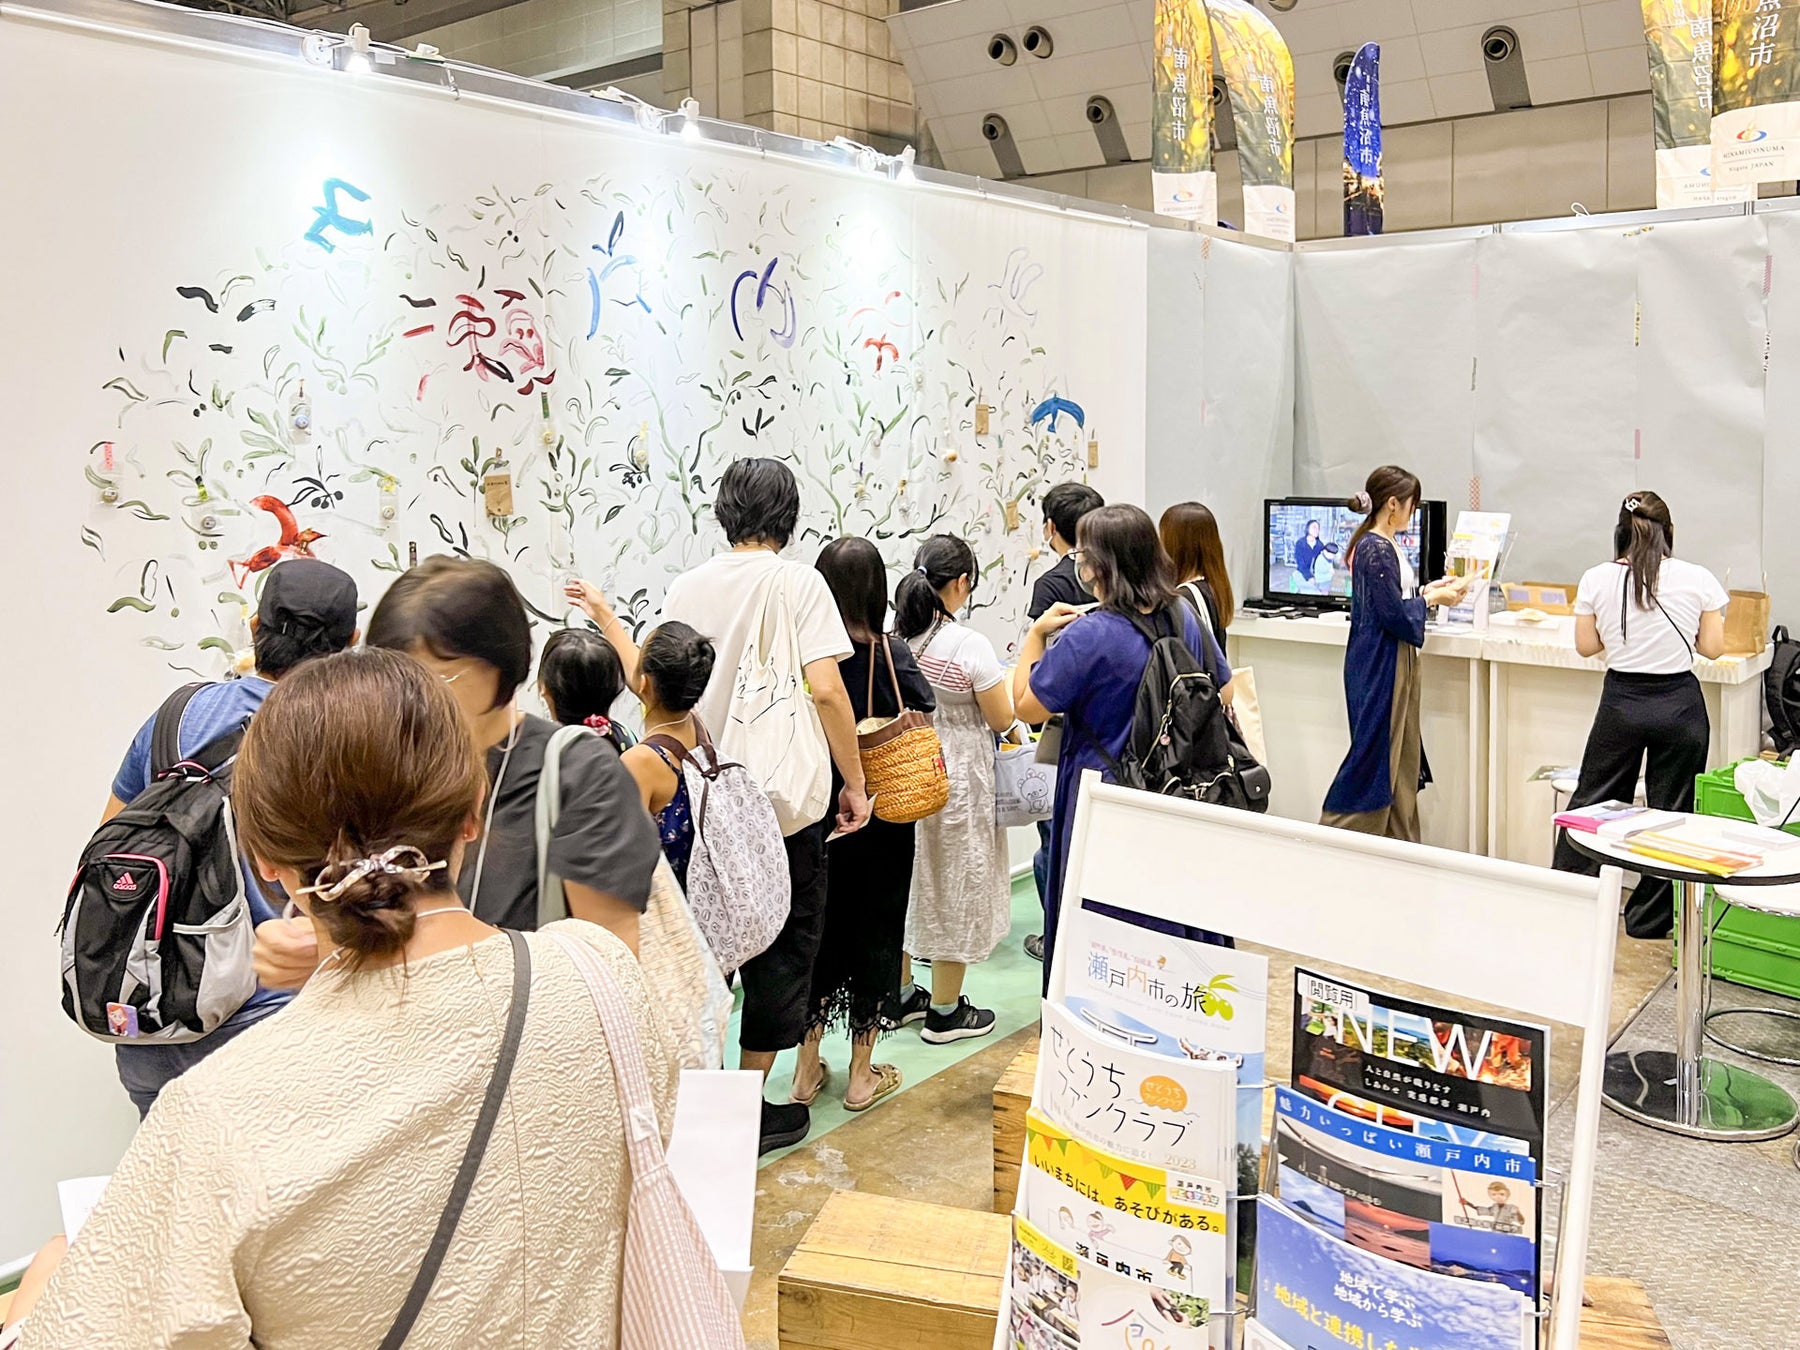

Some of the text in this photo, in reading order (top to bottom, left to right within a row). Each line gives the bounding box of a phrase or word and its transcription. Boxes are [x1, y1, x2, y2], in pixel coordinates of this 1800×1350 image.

[113, 883, 137, 891] adidas
[1088, 951, 1207, 1014] 瀬戸内市の旅
[1311, 979, 1355, 1010] 閲覧用
[1050, 1024, 1126, 1100] せとうち
[1335, 1003, 1493, 1081] NEW
[1058, 1070, 1193, 1147] ファンクラブ
[1279, 1095, 1521, 1173] 魅力いっぱい瀬戸内市
[1334, 1284, 1423, 1328] 地域から学ぶ
[1339, 1270, 1417, 1310] 地域で学ぶ
